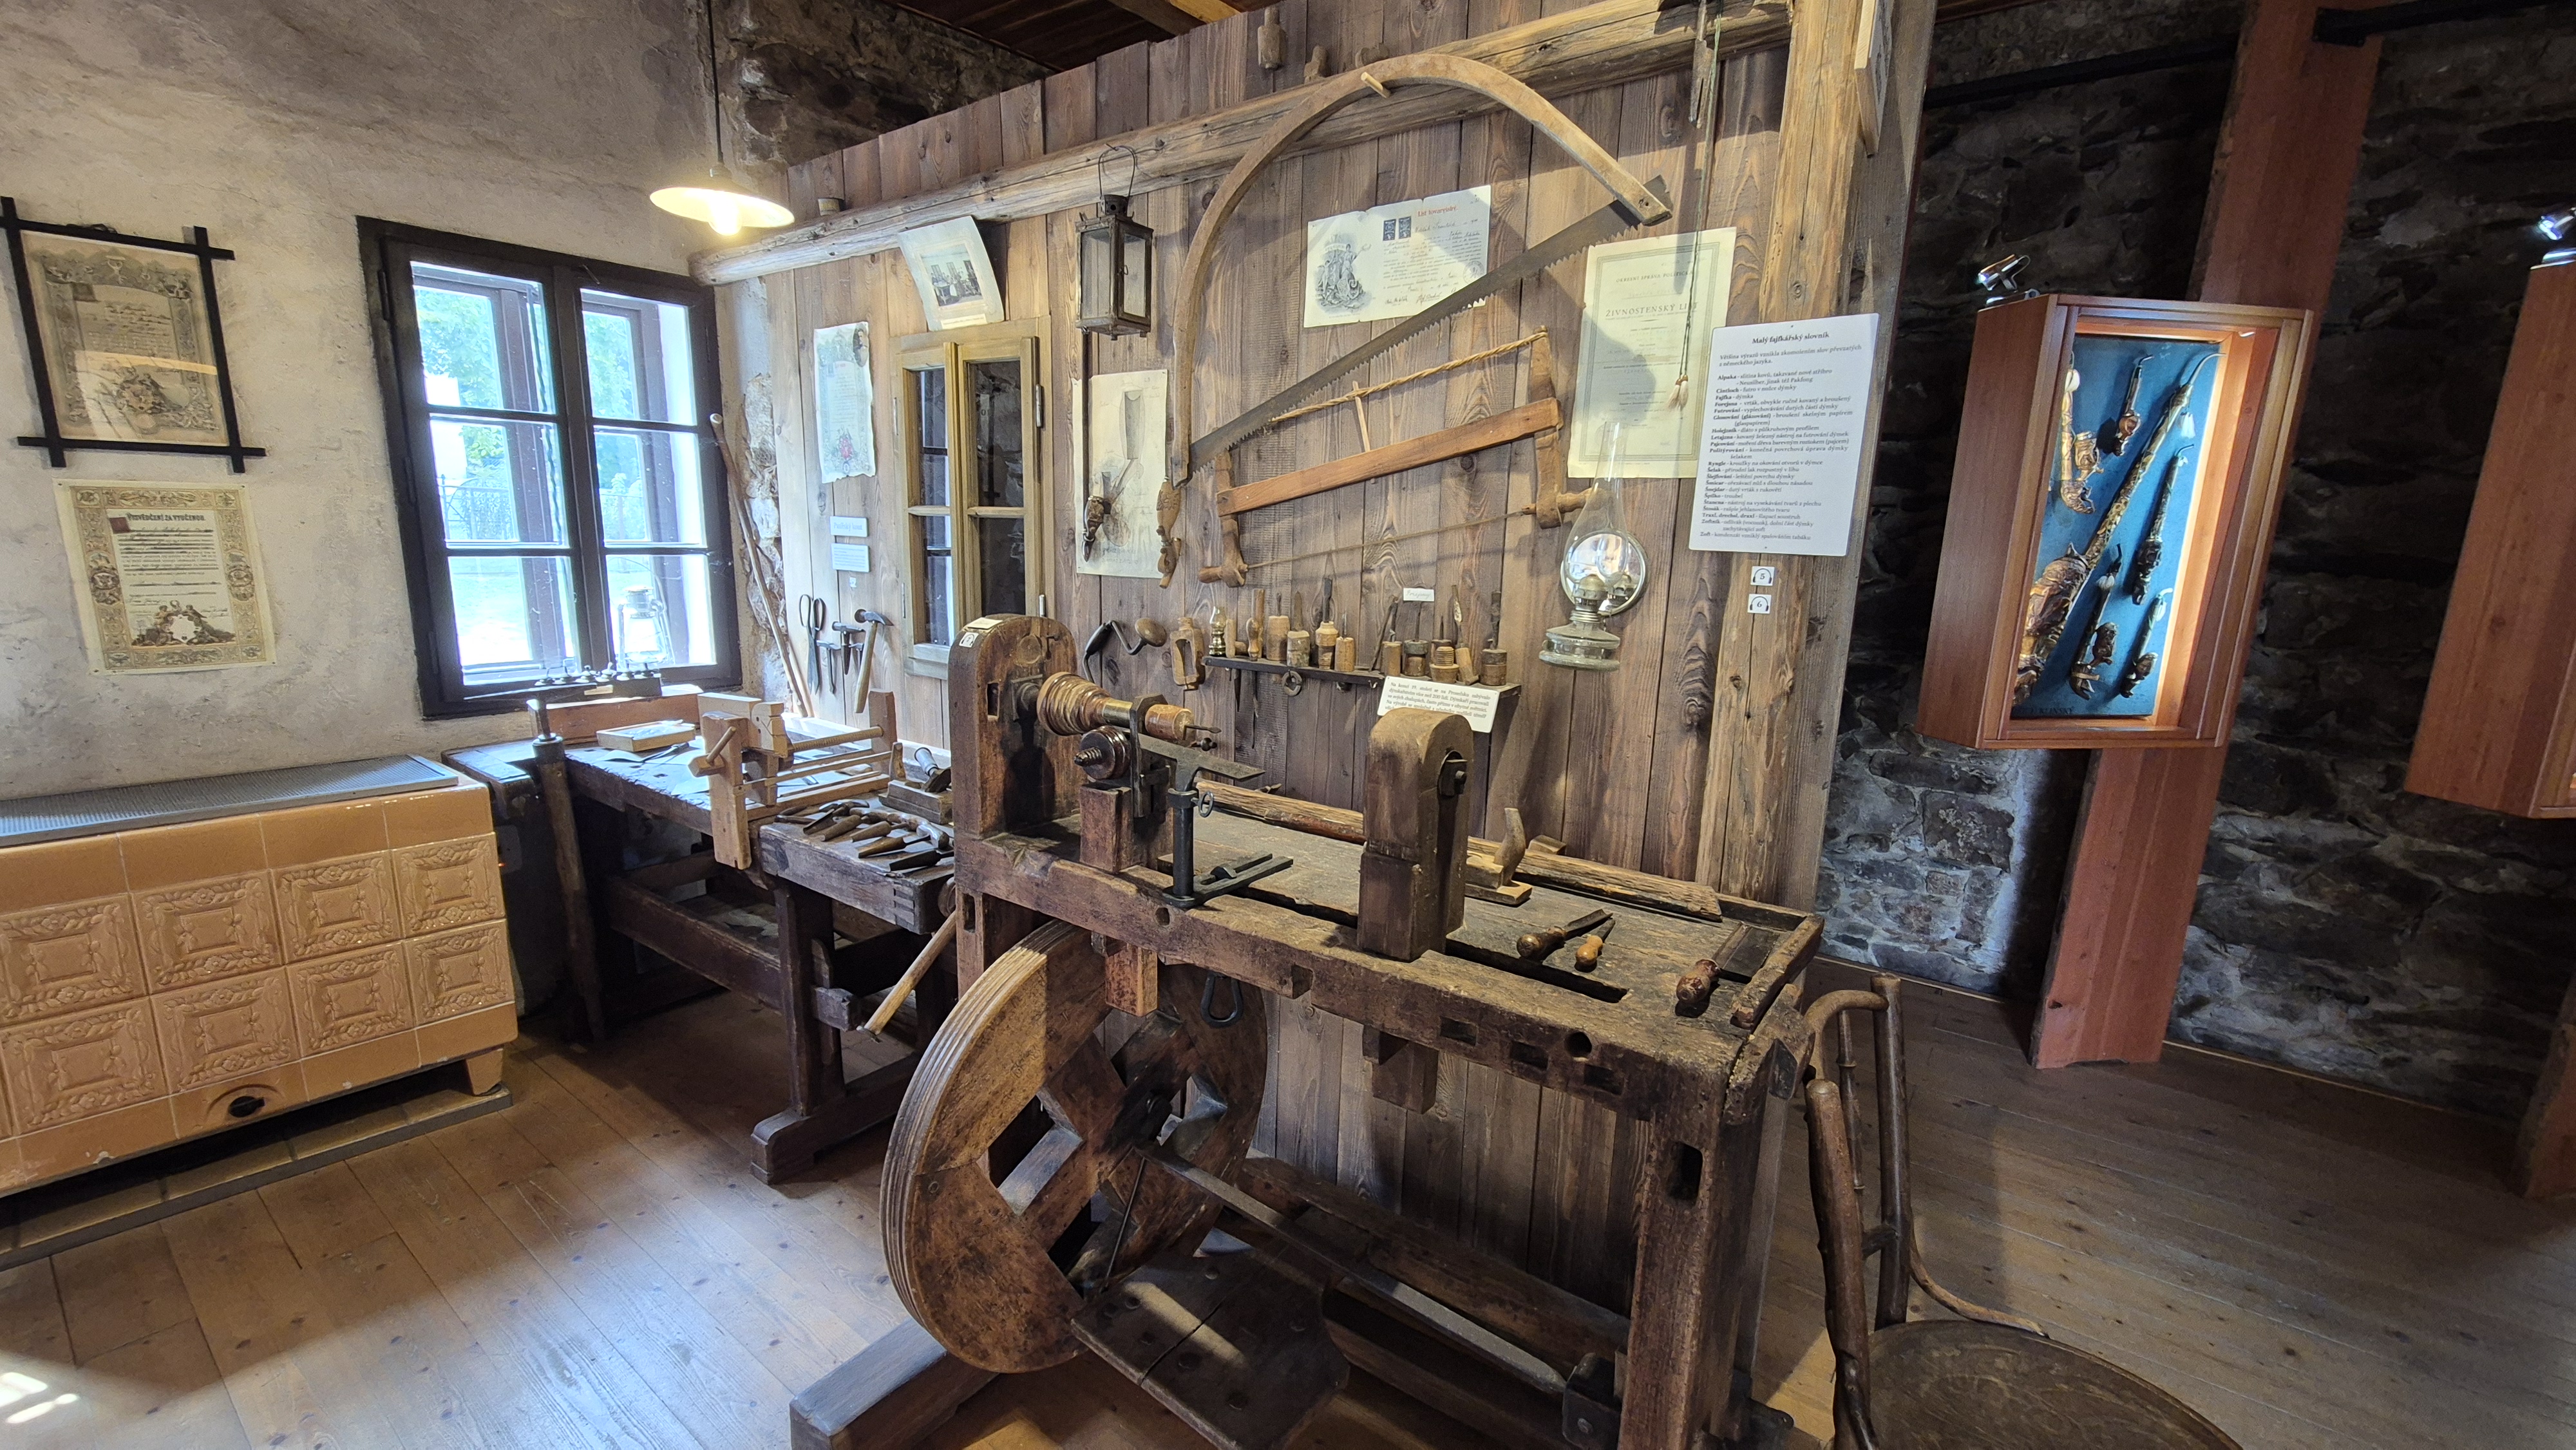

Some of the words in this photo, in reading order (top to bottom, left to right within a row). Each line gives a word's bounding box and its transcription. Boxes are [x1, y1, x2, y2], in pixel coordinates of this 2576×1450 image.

[1605, 304, 1676, 317] ŽIVNOSTENSKÝ
[1680, 302, 1698, 310] LIT
[1769, 334, 1803, 343] fajfkářský
[1804, 331, 1829, 339] slovník
